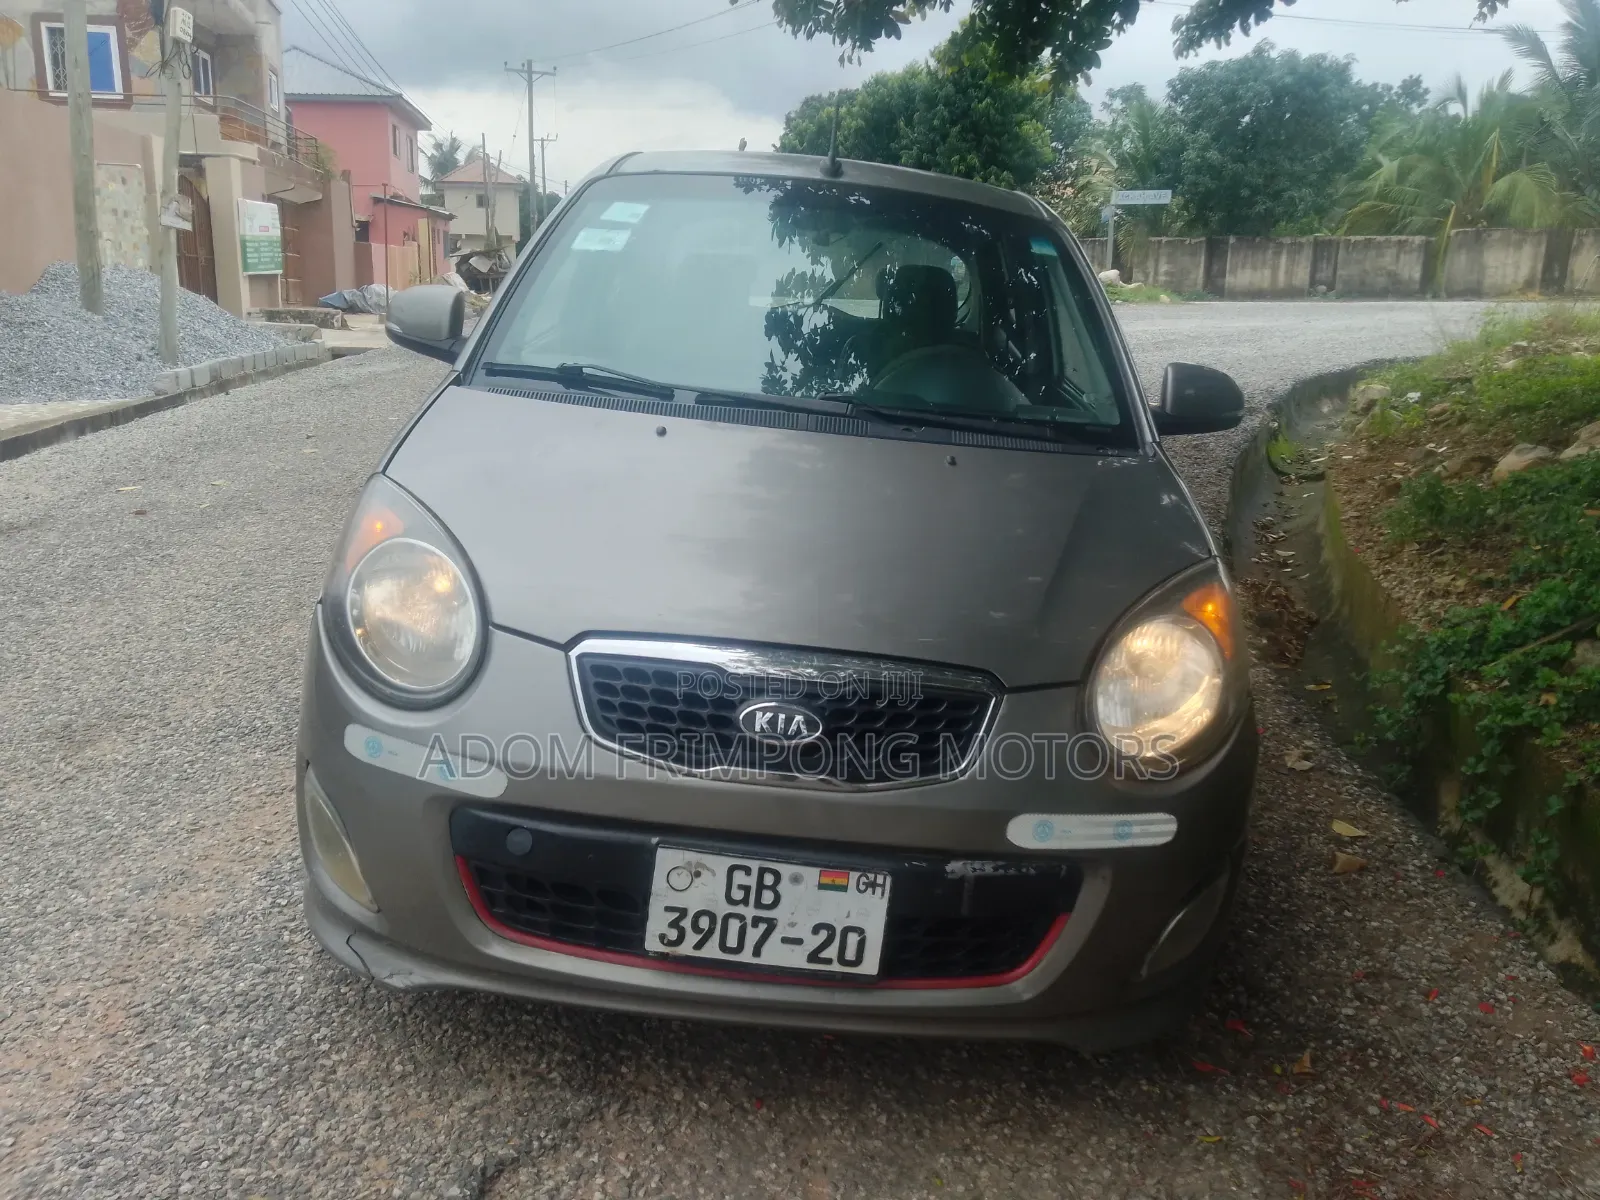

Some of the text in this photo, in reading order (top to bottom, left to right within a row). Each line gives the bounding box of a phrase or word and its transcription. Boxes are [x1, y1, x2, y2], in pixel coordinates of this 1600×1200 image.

[754, 710, 809, 738] KIA
[724, 863, 783, 911] GB
[855, 872, 888, 900] GH
[658, 905, 867, 968] 3907-20
